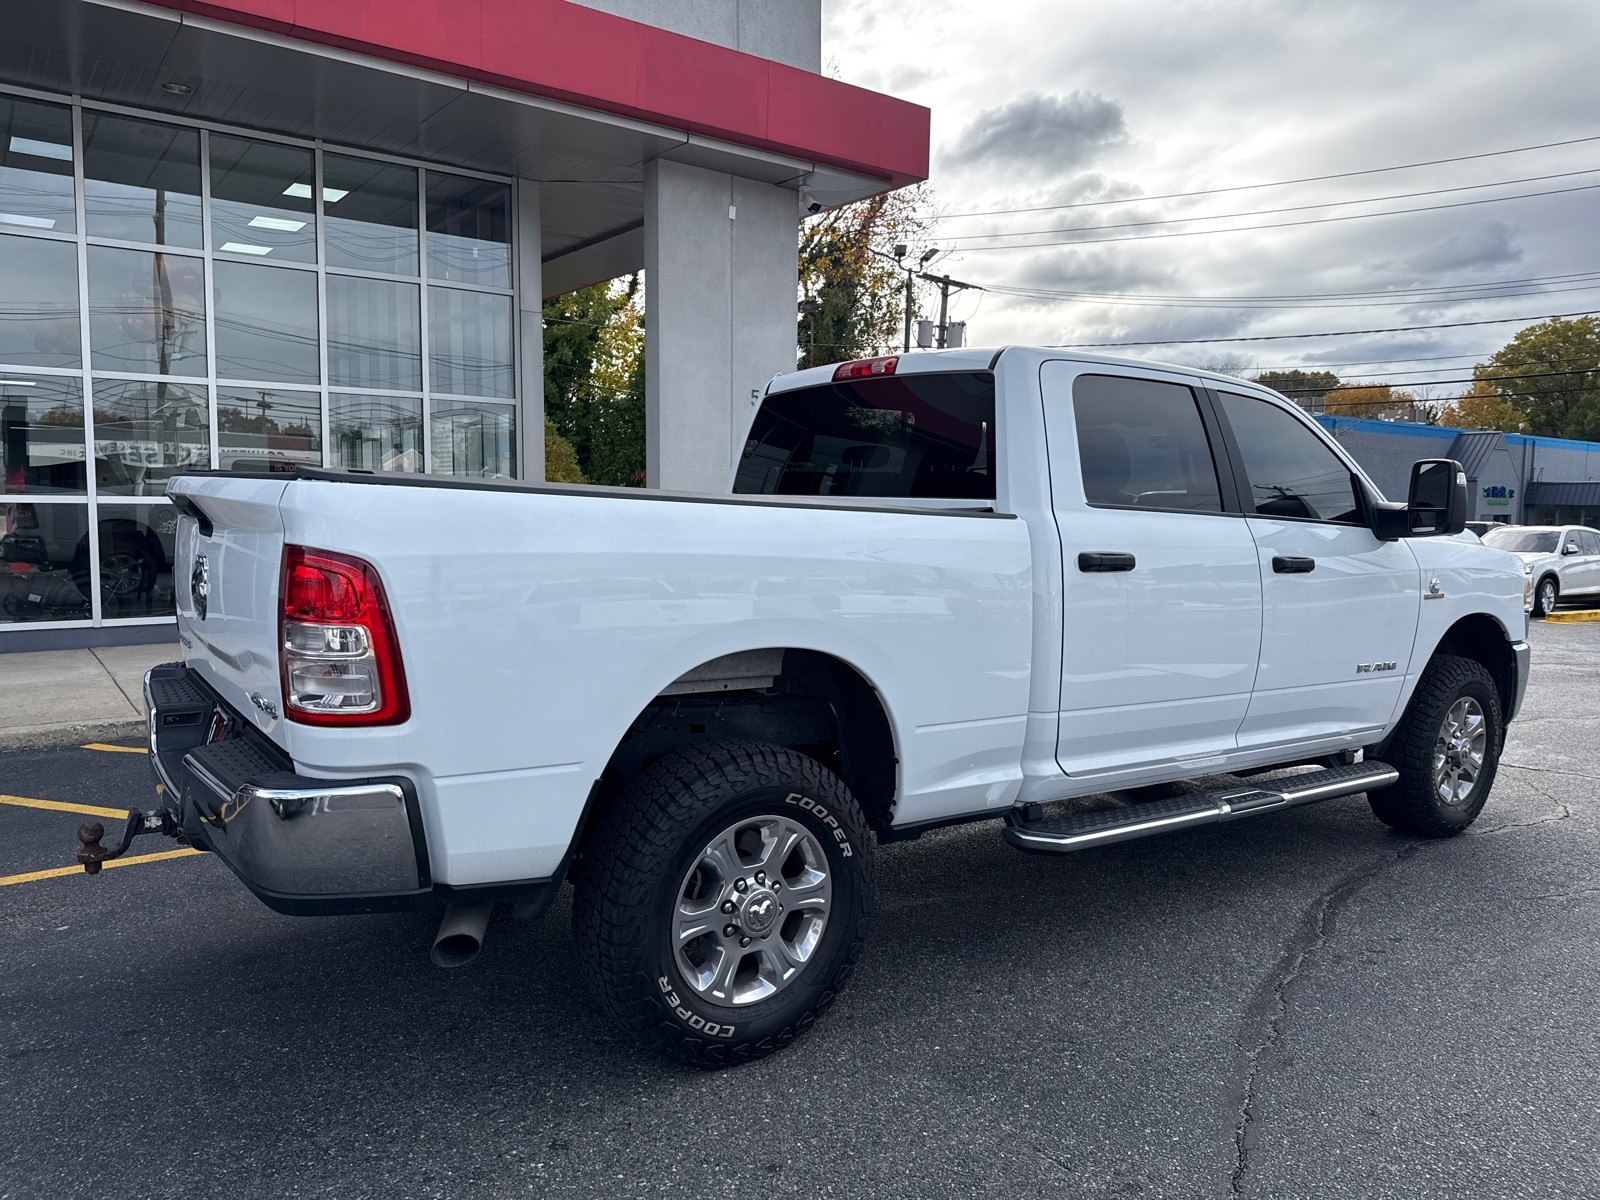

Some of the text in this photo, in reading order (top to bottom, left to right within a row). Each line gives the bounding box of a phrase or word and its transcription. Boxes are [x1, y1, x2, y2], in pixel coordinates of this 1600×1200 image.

[1356, 661, 1397, 674] RAM
[785, 792, 853, 858] COOPER
[657, 975, 736, 1038] COOPER
